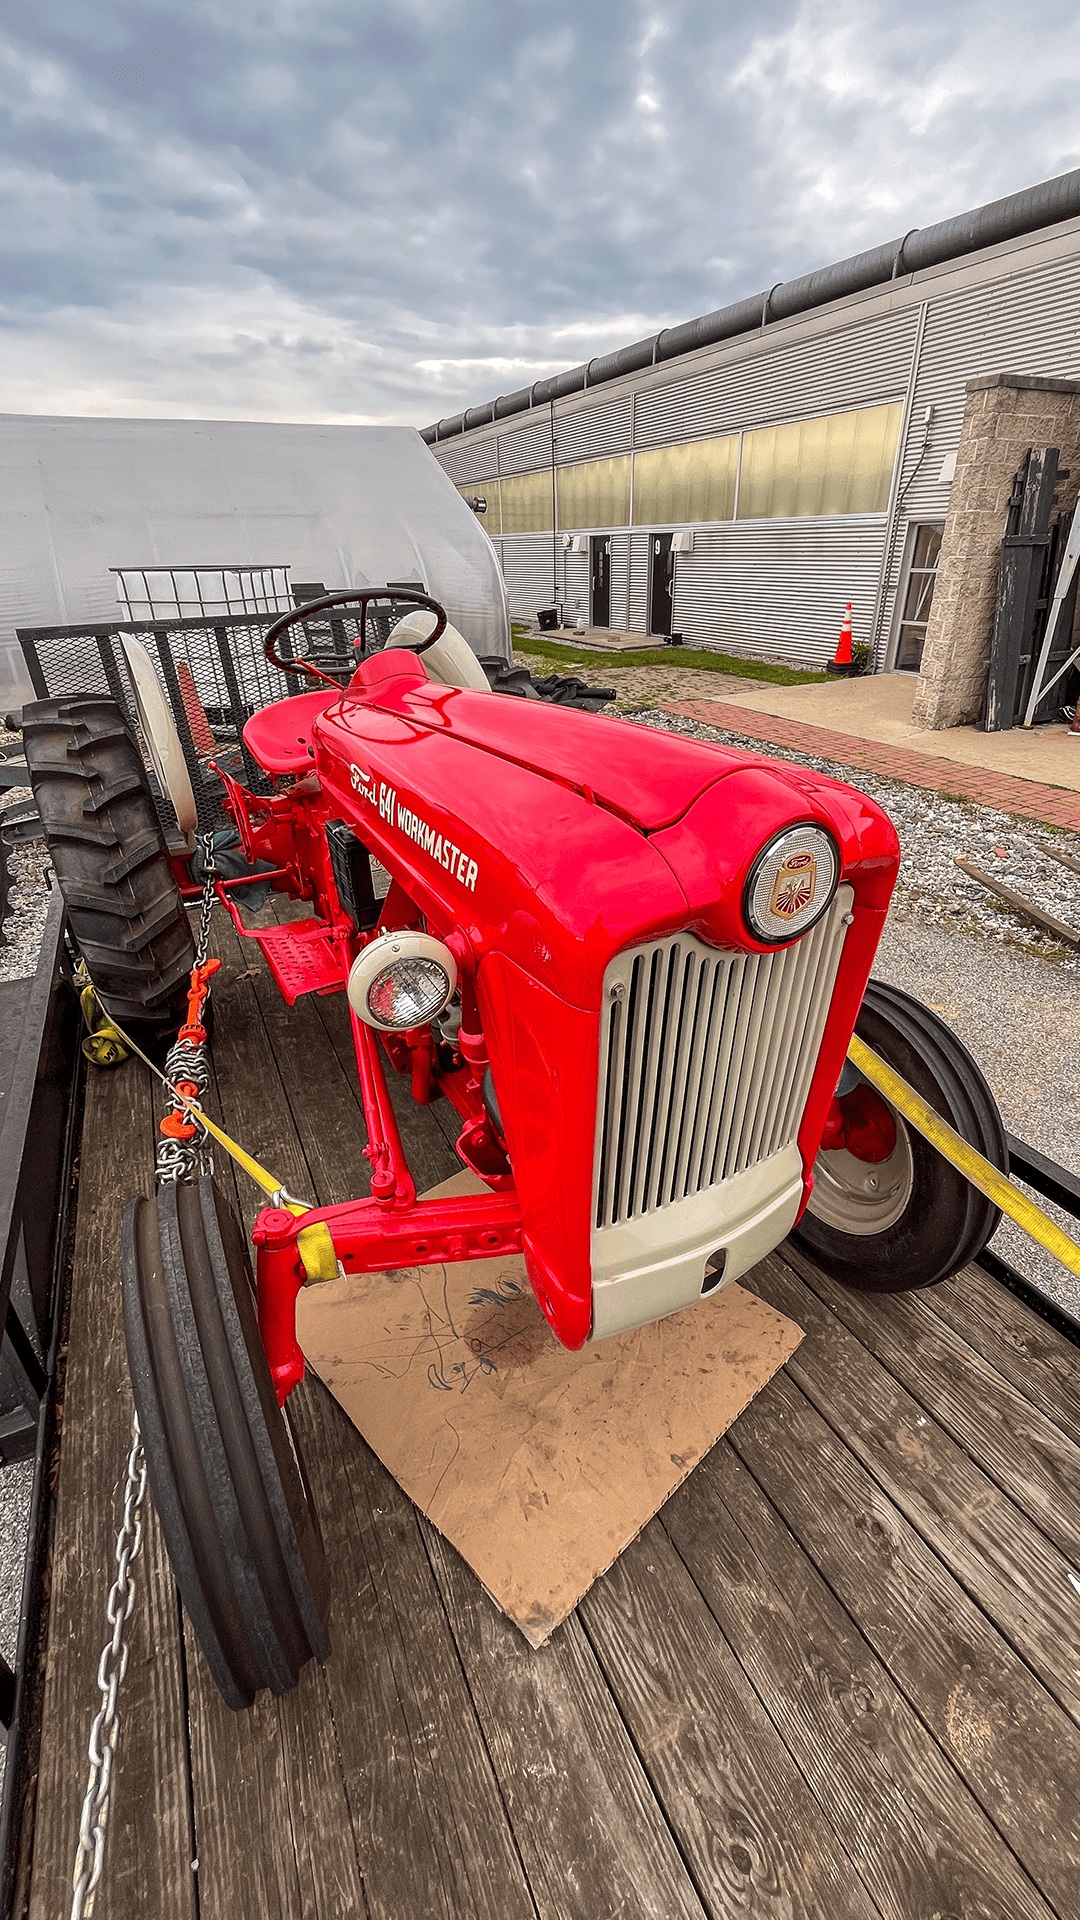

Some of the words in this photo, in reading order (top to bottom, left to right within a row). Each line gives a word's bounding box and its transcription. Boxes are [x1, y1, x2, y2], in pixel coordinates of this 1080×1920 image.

[655, 539, 661, 555] 9
[350, 763, 378, 806] Ford
[379, 782, 396, 827] 641
[397, 802, 479, 893] WORKMASTER
[788, 856, 810, 867] Ford
